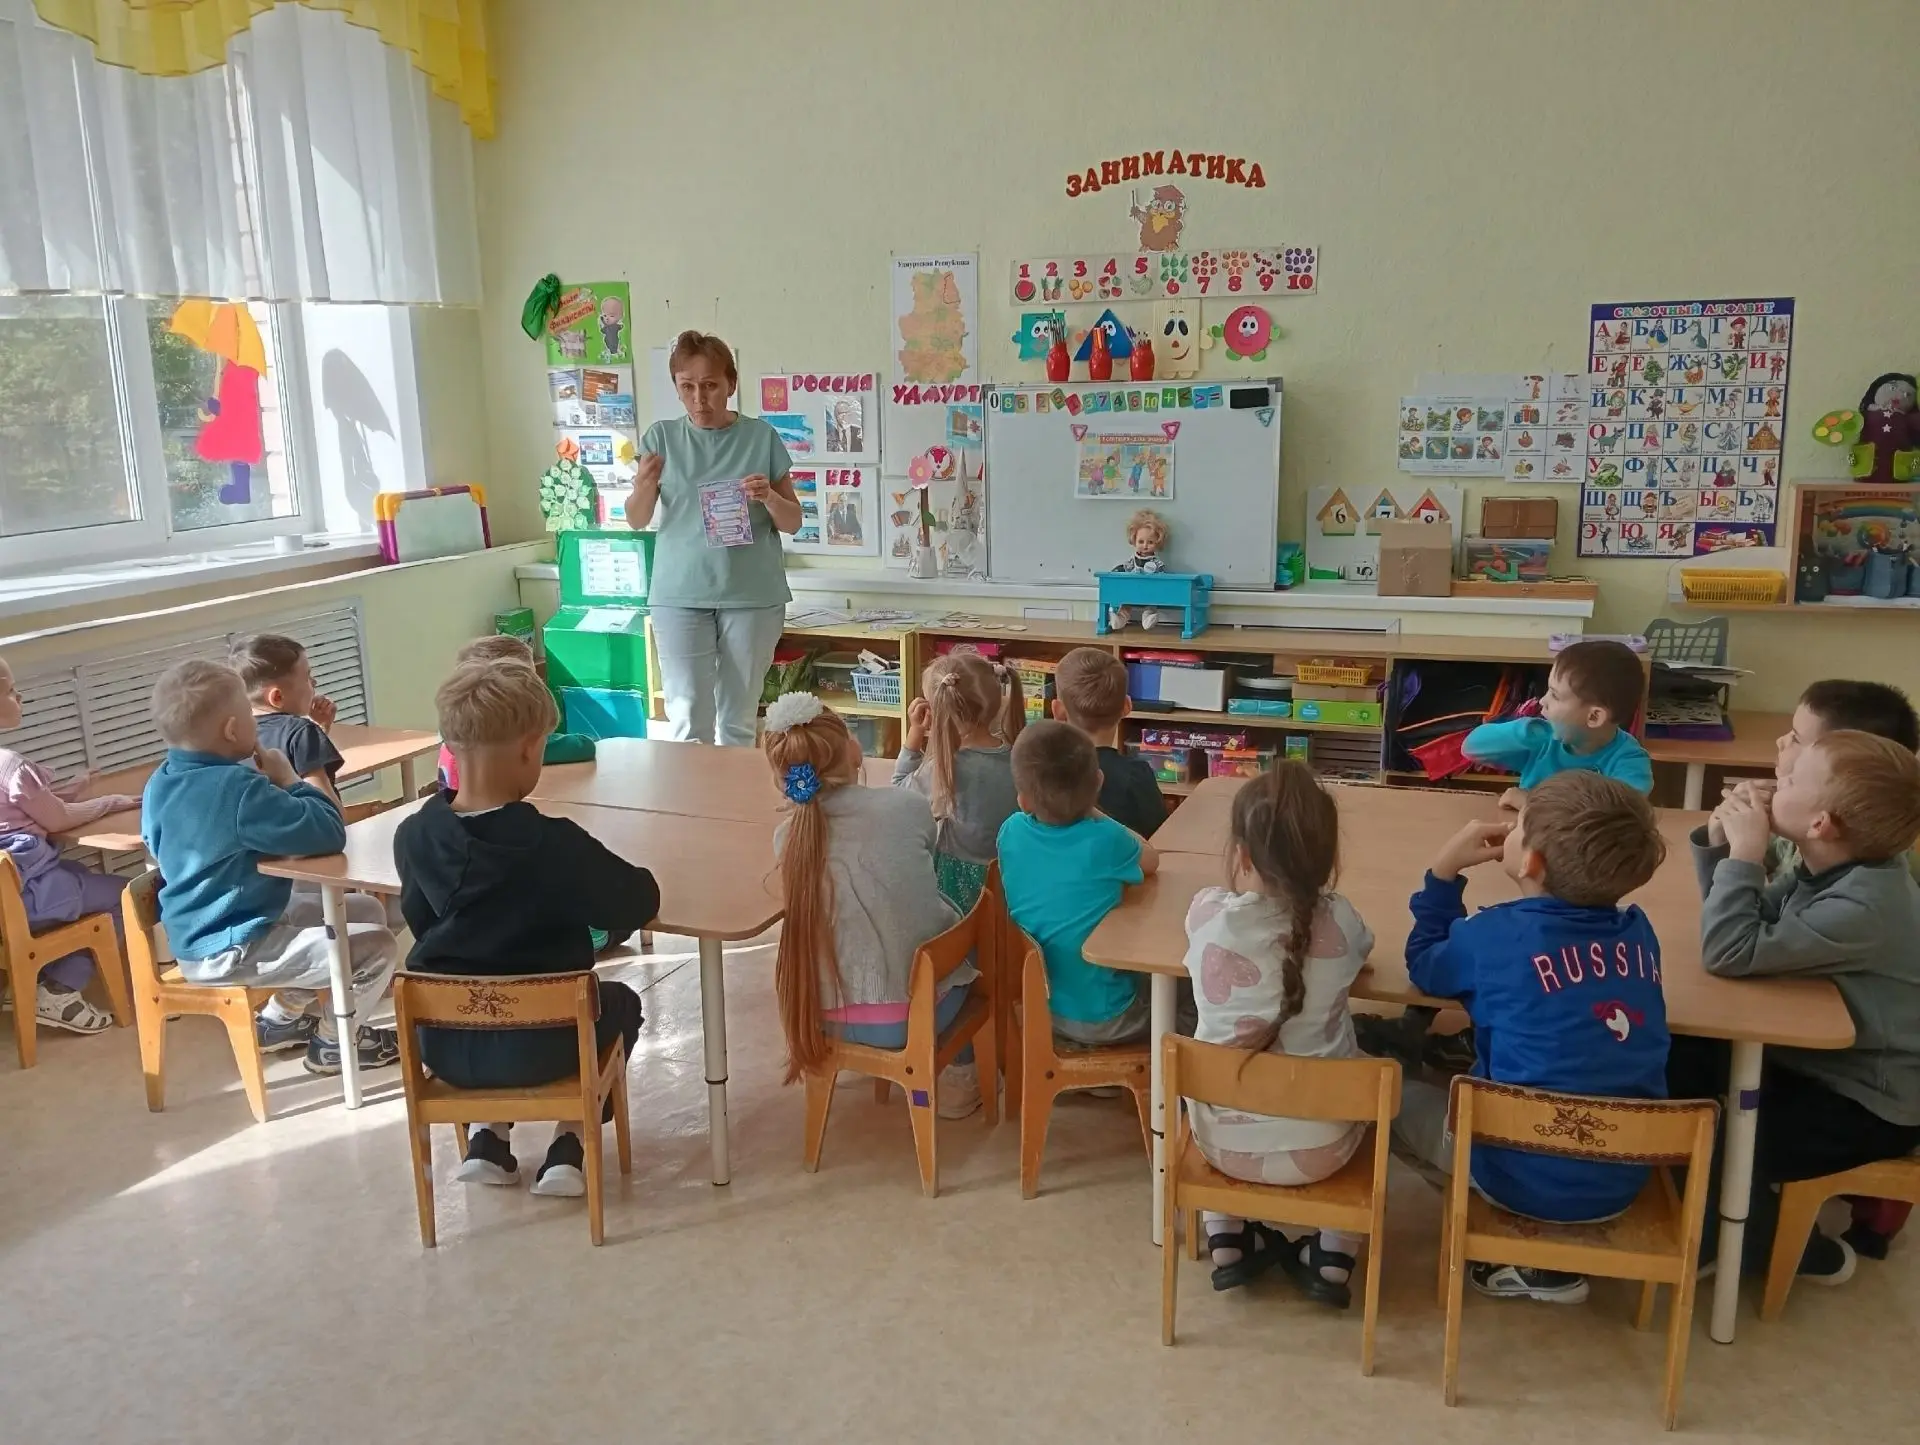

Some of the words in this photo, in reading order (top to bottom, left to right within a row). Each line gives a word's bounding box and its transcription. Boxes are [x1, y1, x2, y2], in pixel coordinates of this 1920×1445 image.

[1066, 149, 1266, 197] ЗАНИМАТИКА
[1019, 264, 1031, 278] 1
[1045, 262, 1058, 276] 2
[1073, 260, 1088, 277] 3
[1103, 258, 1117, 275] 4
[1135, 257, 1149, 274] 5
[1166, 278, 1180, 295] 6
[1197, 276, 1211, 293] 7
[1227, 275, 1242, 292] 8
[1259, 273, 1274, 291] 9
[1286, 274, 1314, 290] 10
[1614, 303, 1701, 318] СКАЗОЧНЫЙ
[1704, 302, 1775, 315] АЛФАВИТ
[1595, 321, 1611, 337] А
[1633, 319, 1649, 336] Б
[1672, 318, 1688, 335] В
[1711, 317, 1727, 334] Г
[1751, 316, 1769, 336] Д
[1593, 356, 1608, 372] Е
[1632, 354, 1645, 371] Ё
[1669, 354, 1691, 370] Ж
[1708, 353, 1722, 370] З
[1749, 352, 1767, 369] И
[792, 374, 873, 393] РОССИЯ
[892, 384, 982, 405] УДМУРТ
[990, 392, 999, 408] 0
[1004, 397, 1012, 409] 8
[1098, 394, 1107, 408] 7
[1113, 394, 1123, 407] 4
[1145, 396, 1158, 408] 10
[1592, 387, 1607, 408] Й
[1630, 389, 1647, 405] К
[1667, 388, 1685, 404] Л
[1707, 388, 1727, 405] М
[1746, 387, 1765, 404] Н
[1589, 424, 1607, 440] О
[1628, 424, 1644, 439] П
[1664, 423, 1679, 439] Р
[1704, 422, 1721, 439] С
[1744, 422, 1760, 438] Т
[1588, 457, 1605, 474] У
[1625, 457, 1645, 473] Ф
[1664, 457, 1679, 473] Х
[1702, 457, 1718, 474] Ц
[1743, 457, 1758, 473] Ч
[1585, 491, 1607, 507] Ш
[1624, 491, 1643, 509] Щ
[1659, 491, 1678, 506] Ъ
[1699, 491, 1719, 507] Ы
[1740, 491, 1754, 506] Ь
[1335, 508, 1346, 524] 6
[1583, 524, 1598, 539] Э
[1620, 523, 1643, 539] Ю
[1658, 524, 1675, 539] Я
[1532, 942, 1662, 992] RUSSIA
